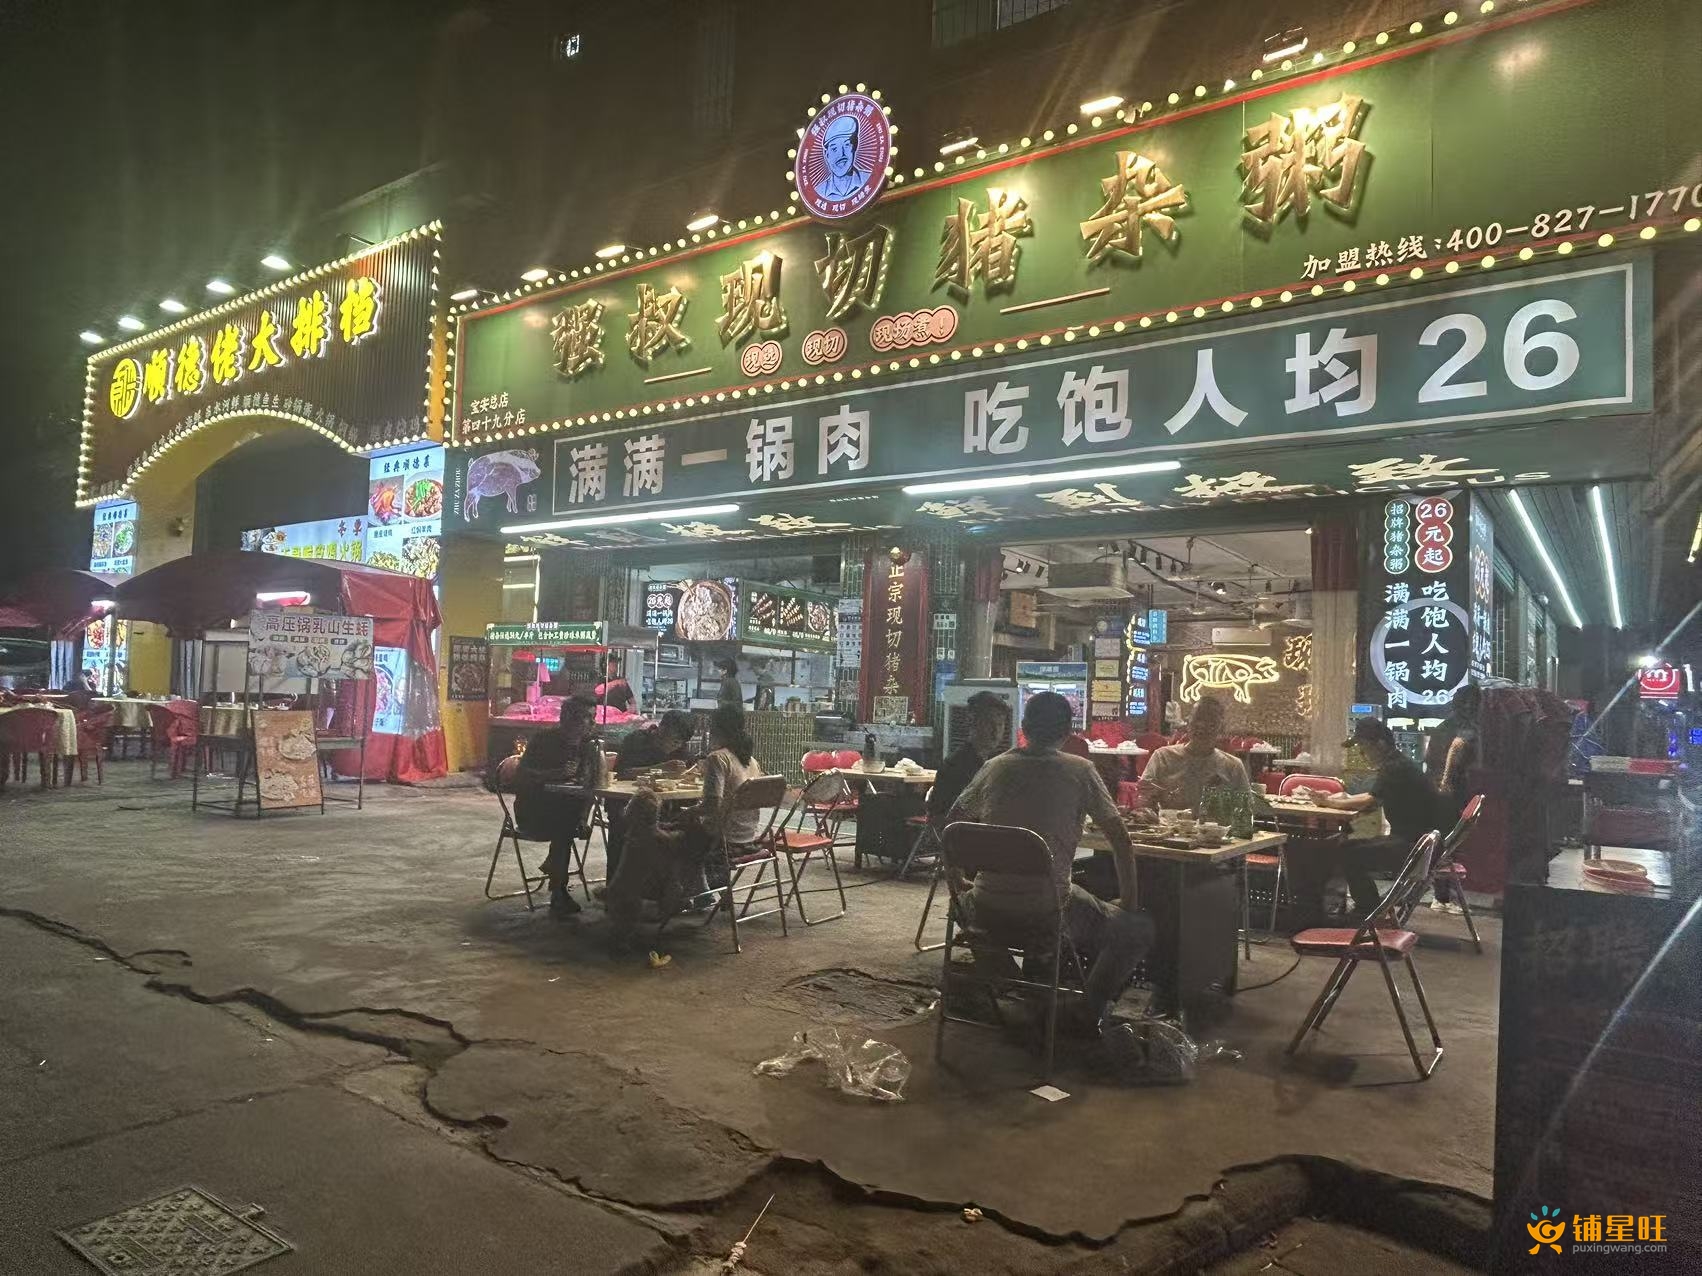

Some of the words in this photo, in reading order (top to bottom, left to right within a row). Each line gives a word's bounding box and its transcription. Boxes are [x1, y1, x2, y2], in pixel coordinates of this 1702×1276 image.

[806, 334, 841, 359] 现切
[462, 408, 526, 434] 第四十九分店
[470, 392, 509, 415] 宝安总店
[568, 405, 872, 504] 满满一锅肉
[963, 299, 1580, 456] 吃饱人均26
[1390, 503, 1405, 570] 招牌猪杂粥
[1419, 503, 1447, 566] 26元起
[265, 615, 369, 637] 高压锅乳山生蚝
[1384, 582, 1410, 709] 满满一锅肉
[1420, 580, 1450, 705] 吃饱人均26
